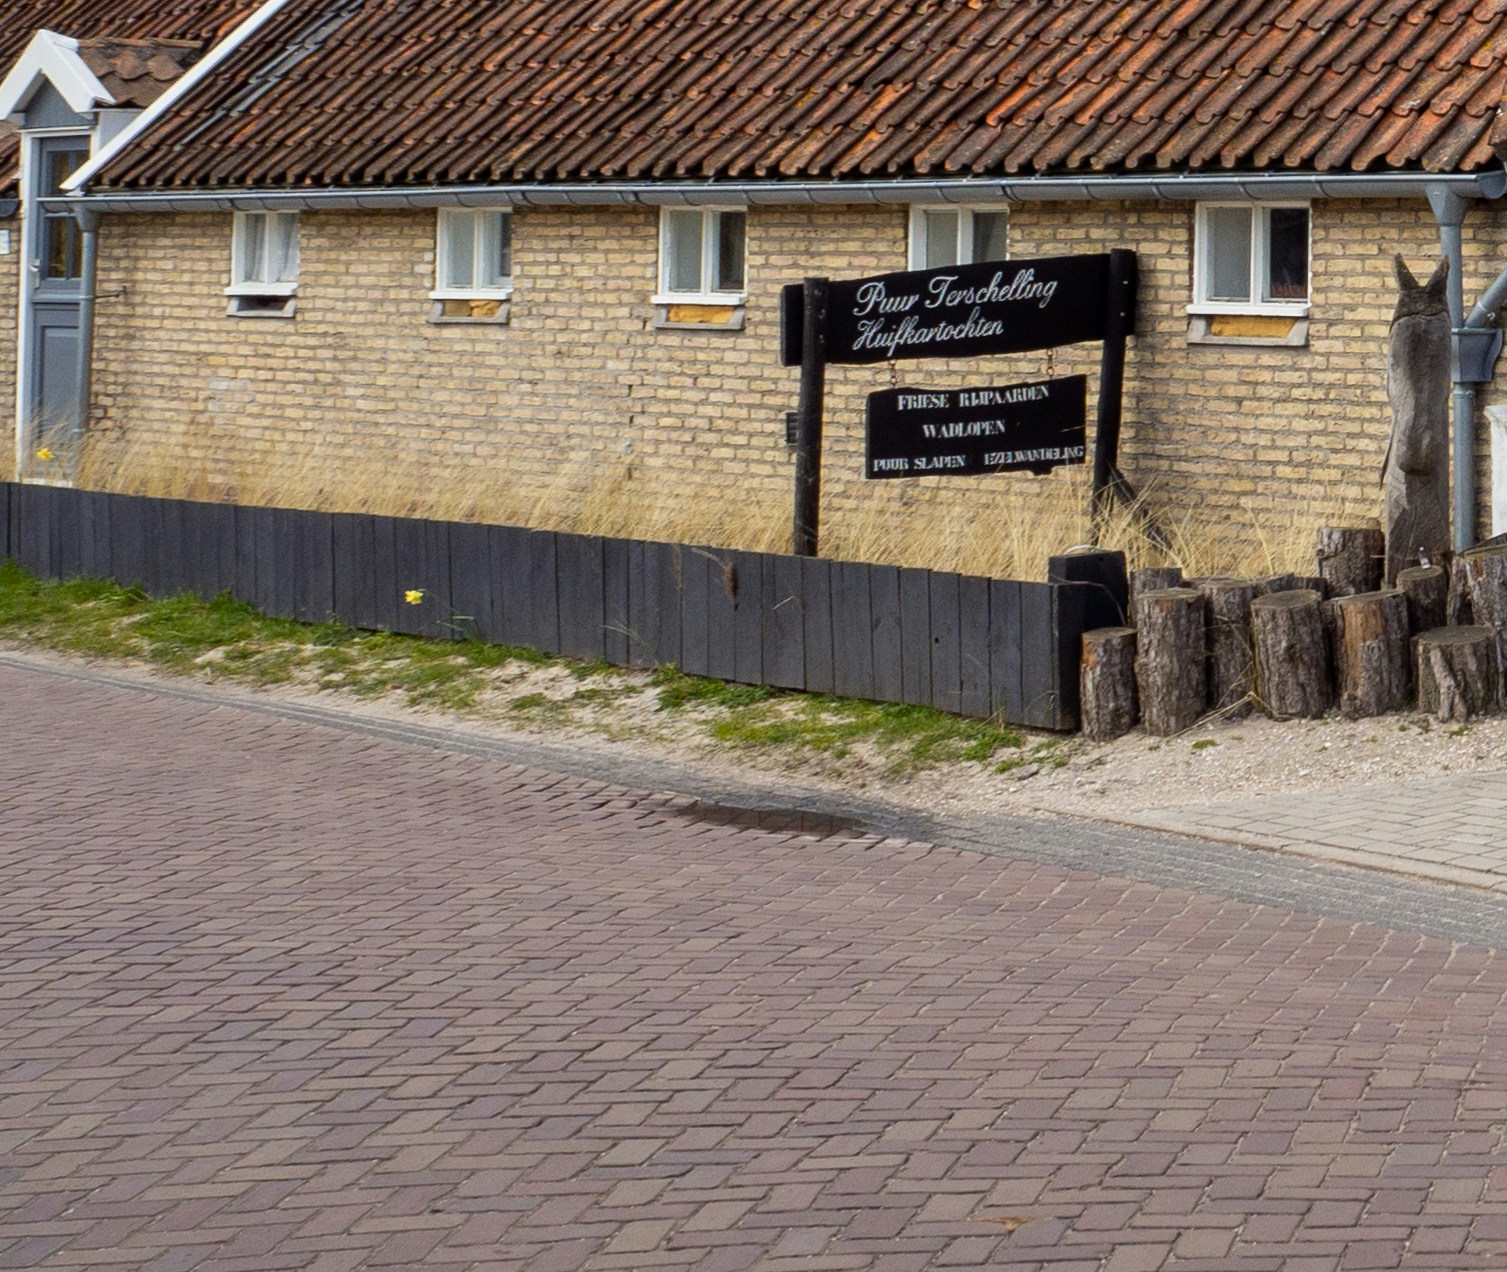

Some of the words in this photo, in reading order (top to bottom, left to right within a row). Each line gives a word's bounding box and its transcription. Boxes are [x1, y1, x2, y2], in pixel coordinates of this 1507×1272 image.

[853, 281, 919, 316] Puur
[924, 267, 1058, 308] Terschelling
[852, 306, 1004, 357] Huifkartochten
[897, 394, 950, 410] FRIESE
[959, 385, 1049, 408] RIJPAARDEN
[922, 420, 1006, 439] WADLOPEN
[873, 459, 909, 472] PUUR
[913, 455, 967, 470] SLAPEN
[984, 446, 1084, 466] EZELWANDELING
